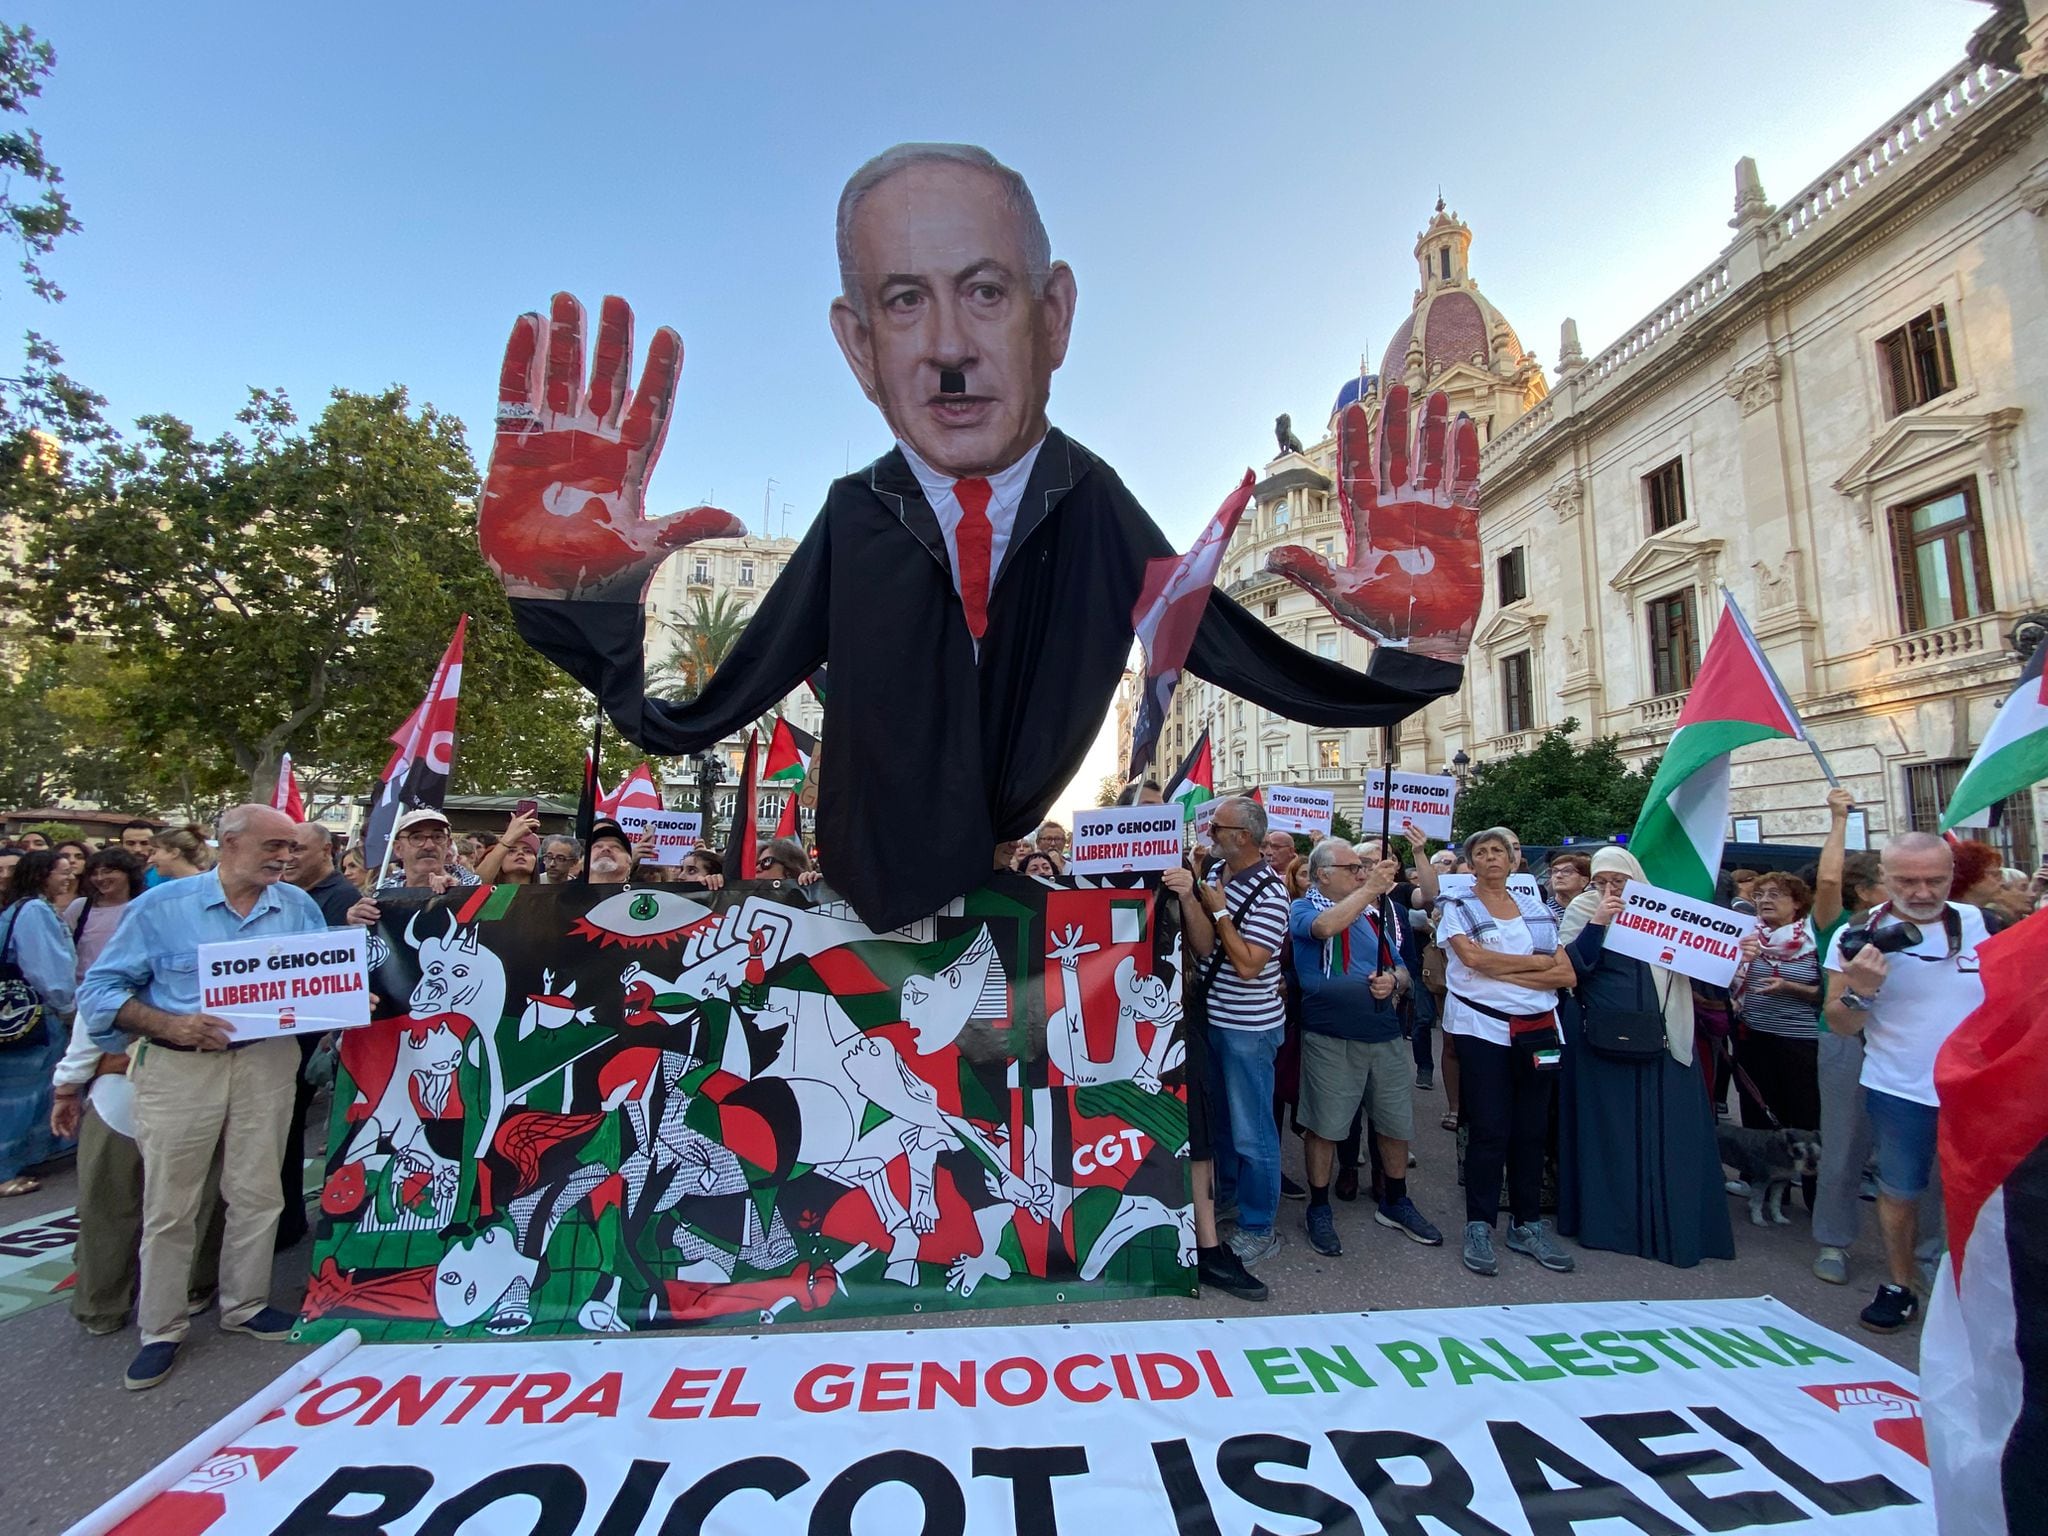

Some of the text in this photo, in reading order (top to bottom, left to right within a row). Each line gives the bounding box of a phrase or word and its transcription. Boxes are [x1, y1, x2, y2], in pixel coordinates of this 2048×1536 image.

[1273, 794, 1329, 807] STOP GENOCIDI
[1373, 781, 1449, 797] STP GENOCIDI
[1268, 805, 1330, 819] LLIBERTAT FLOTILLA
[1367, 796, 1450, 816] LLIBRTAT FLOTILLA
[1081, 819, 1176, 837] STOP GENOCIDI
[1076, 839, 1179, 861] LLIBERTAT FLOTILLA
[1628, 895, 1743, 938] STOP GENOCIDI
[1615, 912, 1739, 961] LLIBERTAT FLOTILLA
[211, 948, 355, 976] STOP GENOCIDI
[205, 972, 363, 1008] LLIBERTAT FLOTILLA
[1072, 1128, 1145, 1176] CGT
[648, 1367, 761, 1419] EL
[792, 1350, 1234, 1413] GENOCIDI
[1242, 1345, 1379, 1396] EN
[1375, 1325, 1855, 1388] PALESTINA
[268, 1406, 1922, 1536] BOICOT ISRAEL
